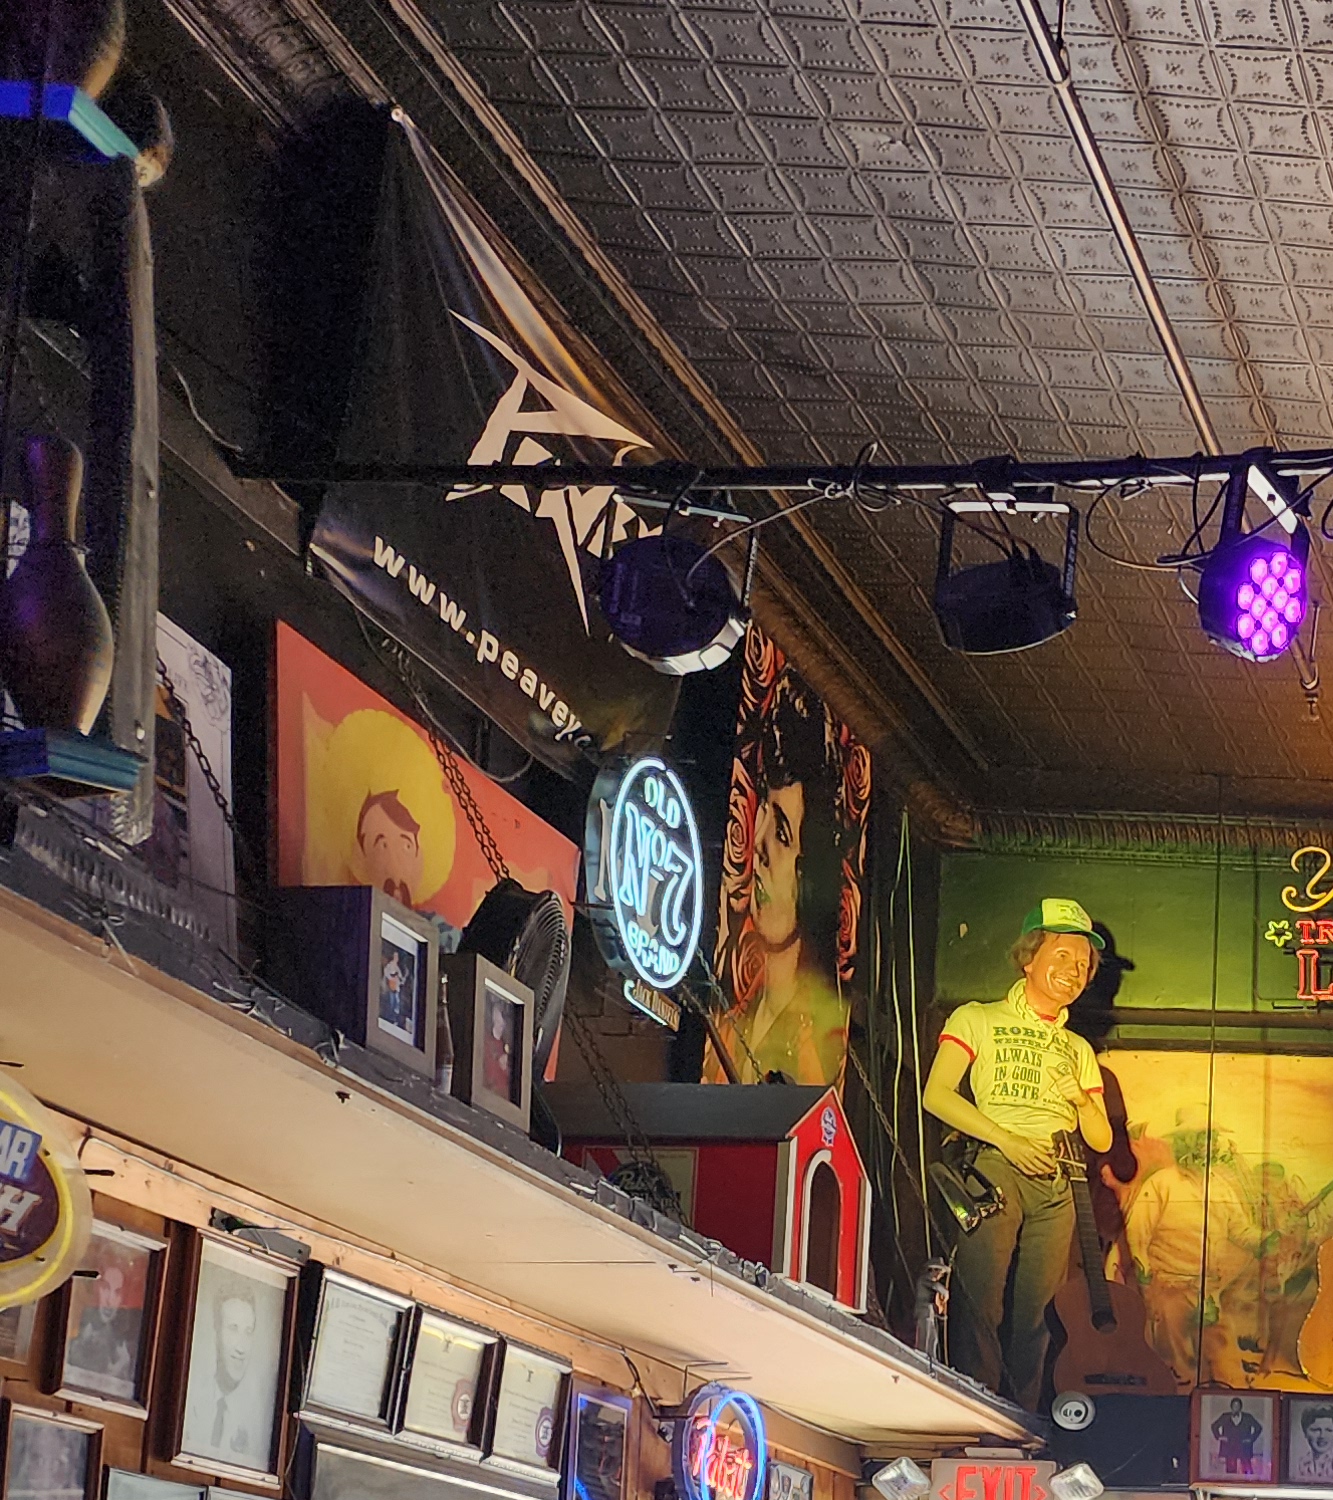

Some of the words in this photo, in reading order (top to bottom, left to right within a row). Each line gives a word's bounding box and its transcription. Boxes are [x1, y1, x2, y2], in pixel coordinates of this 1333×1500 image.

[643, 776, 682, 829] OLD
[627, 920, 681, 976] BRAND
[994, 1049, 1043, 1068] ALWAYS
[993, 1065, 1007, 1083] IN
[1012, 1065, 1041, 1084] GOOD
[990, 1080, 1040, 1100] TASTE
